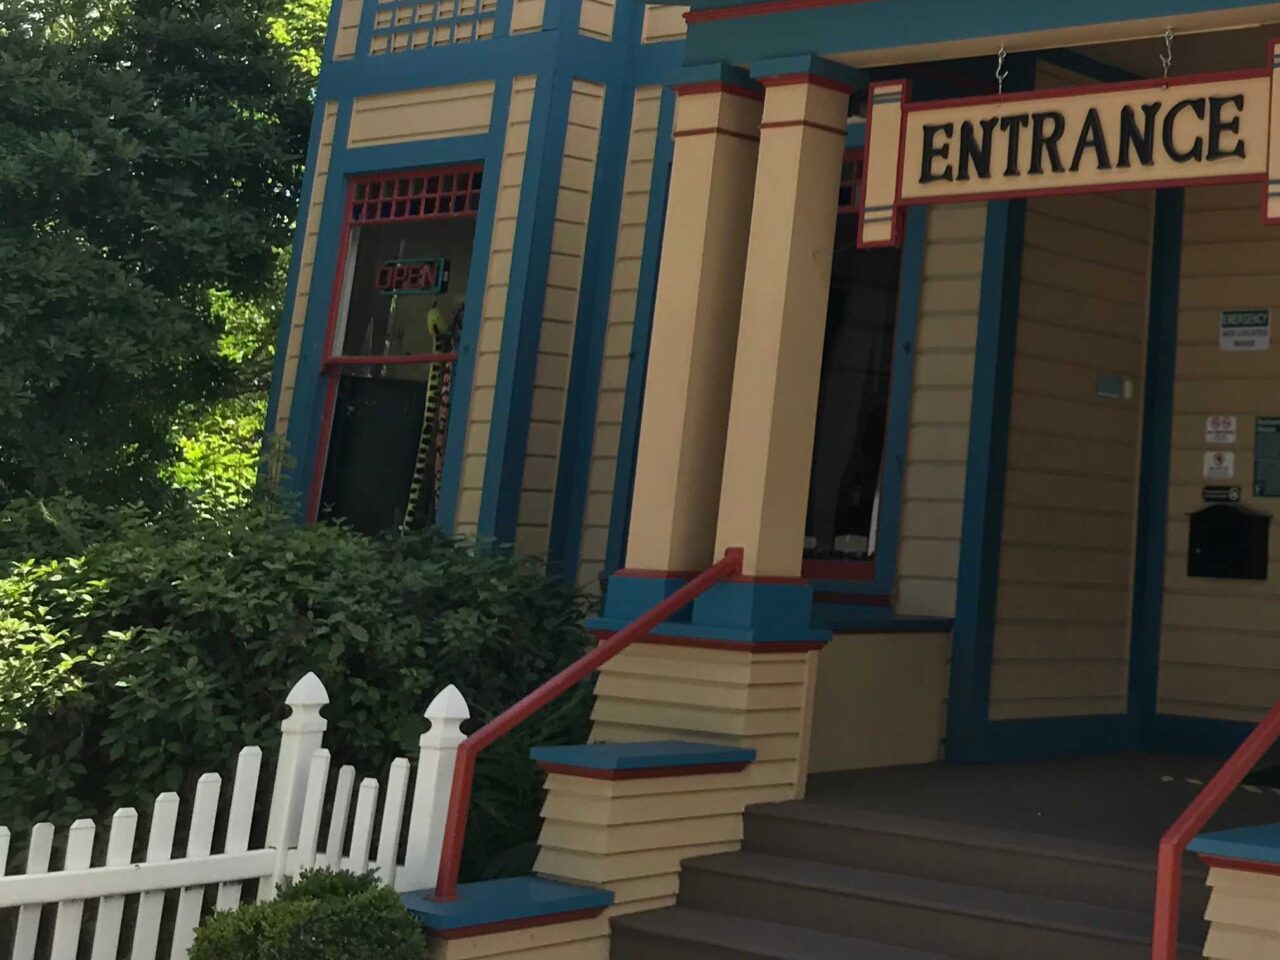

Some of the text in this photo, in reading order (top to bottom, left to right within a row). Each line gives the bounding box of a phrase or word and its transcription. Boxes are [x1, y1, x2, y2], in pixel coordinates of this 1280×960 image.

[918, 94, 1245, 184] ENTRANCE
[376, 265, 435, 290] OPEN
[1222, 313, 1268, 325] EMERGENCY
